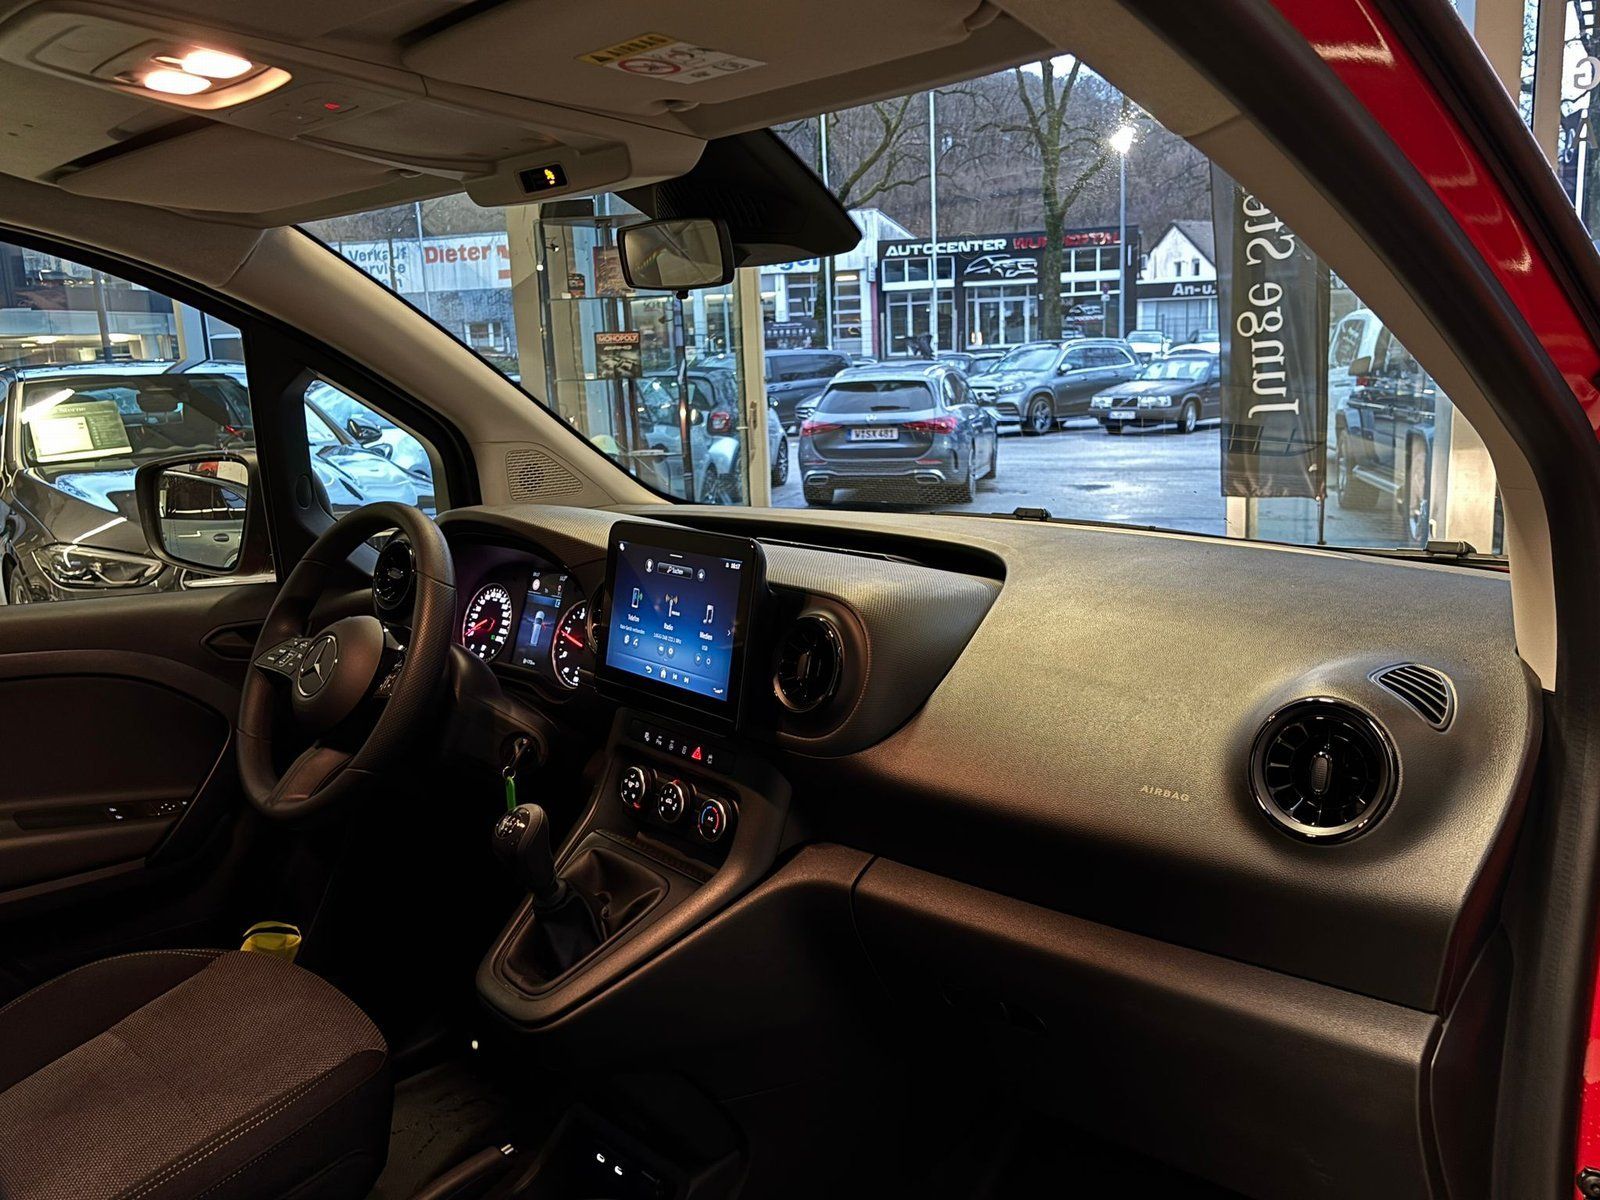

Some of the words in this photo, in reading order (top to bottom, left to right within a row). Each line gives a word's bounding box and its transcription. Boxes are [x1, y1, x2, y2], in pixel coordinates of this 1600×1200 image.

[424, 244, 492, 265] Dieter
[885, 239, 1007, 257] AUTOCENTER
[1140, 785, 1190, 802] AIRBAG
